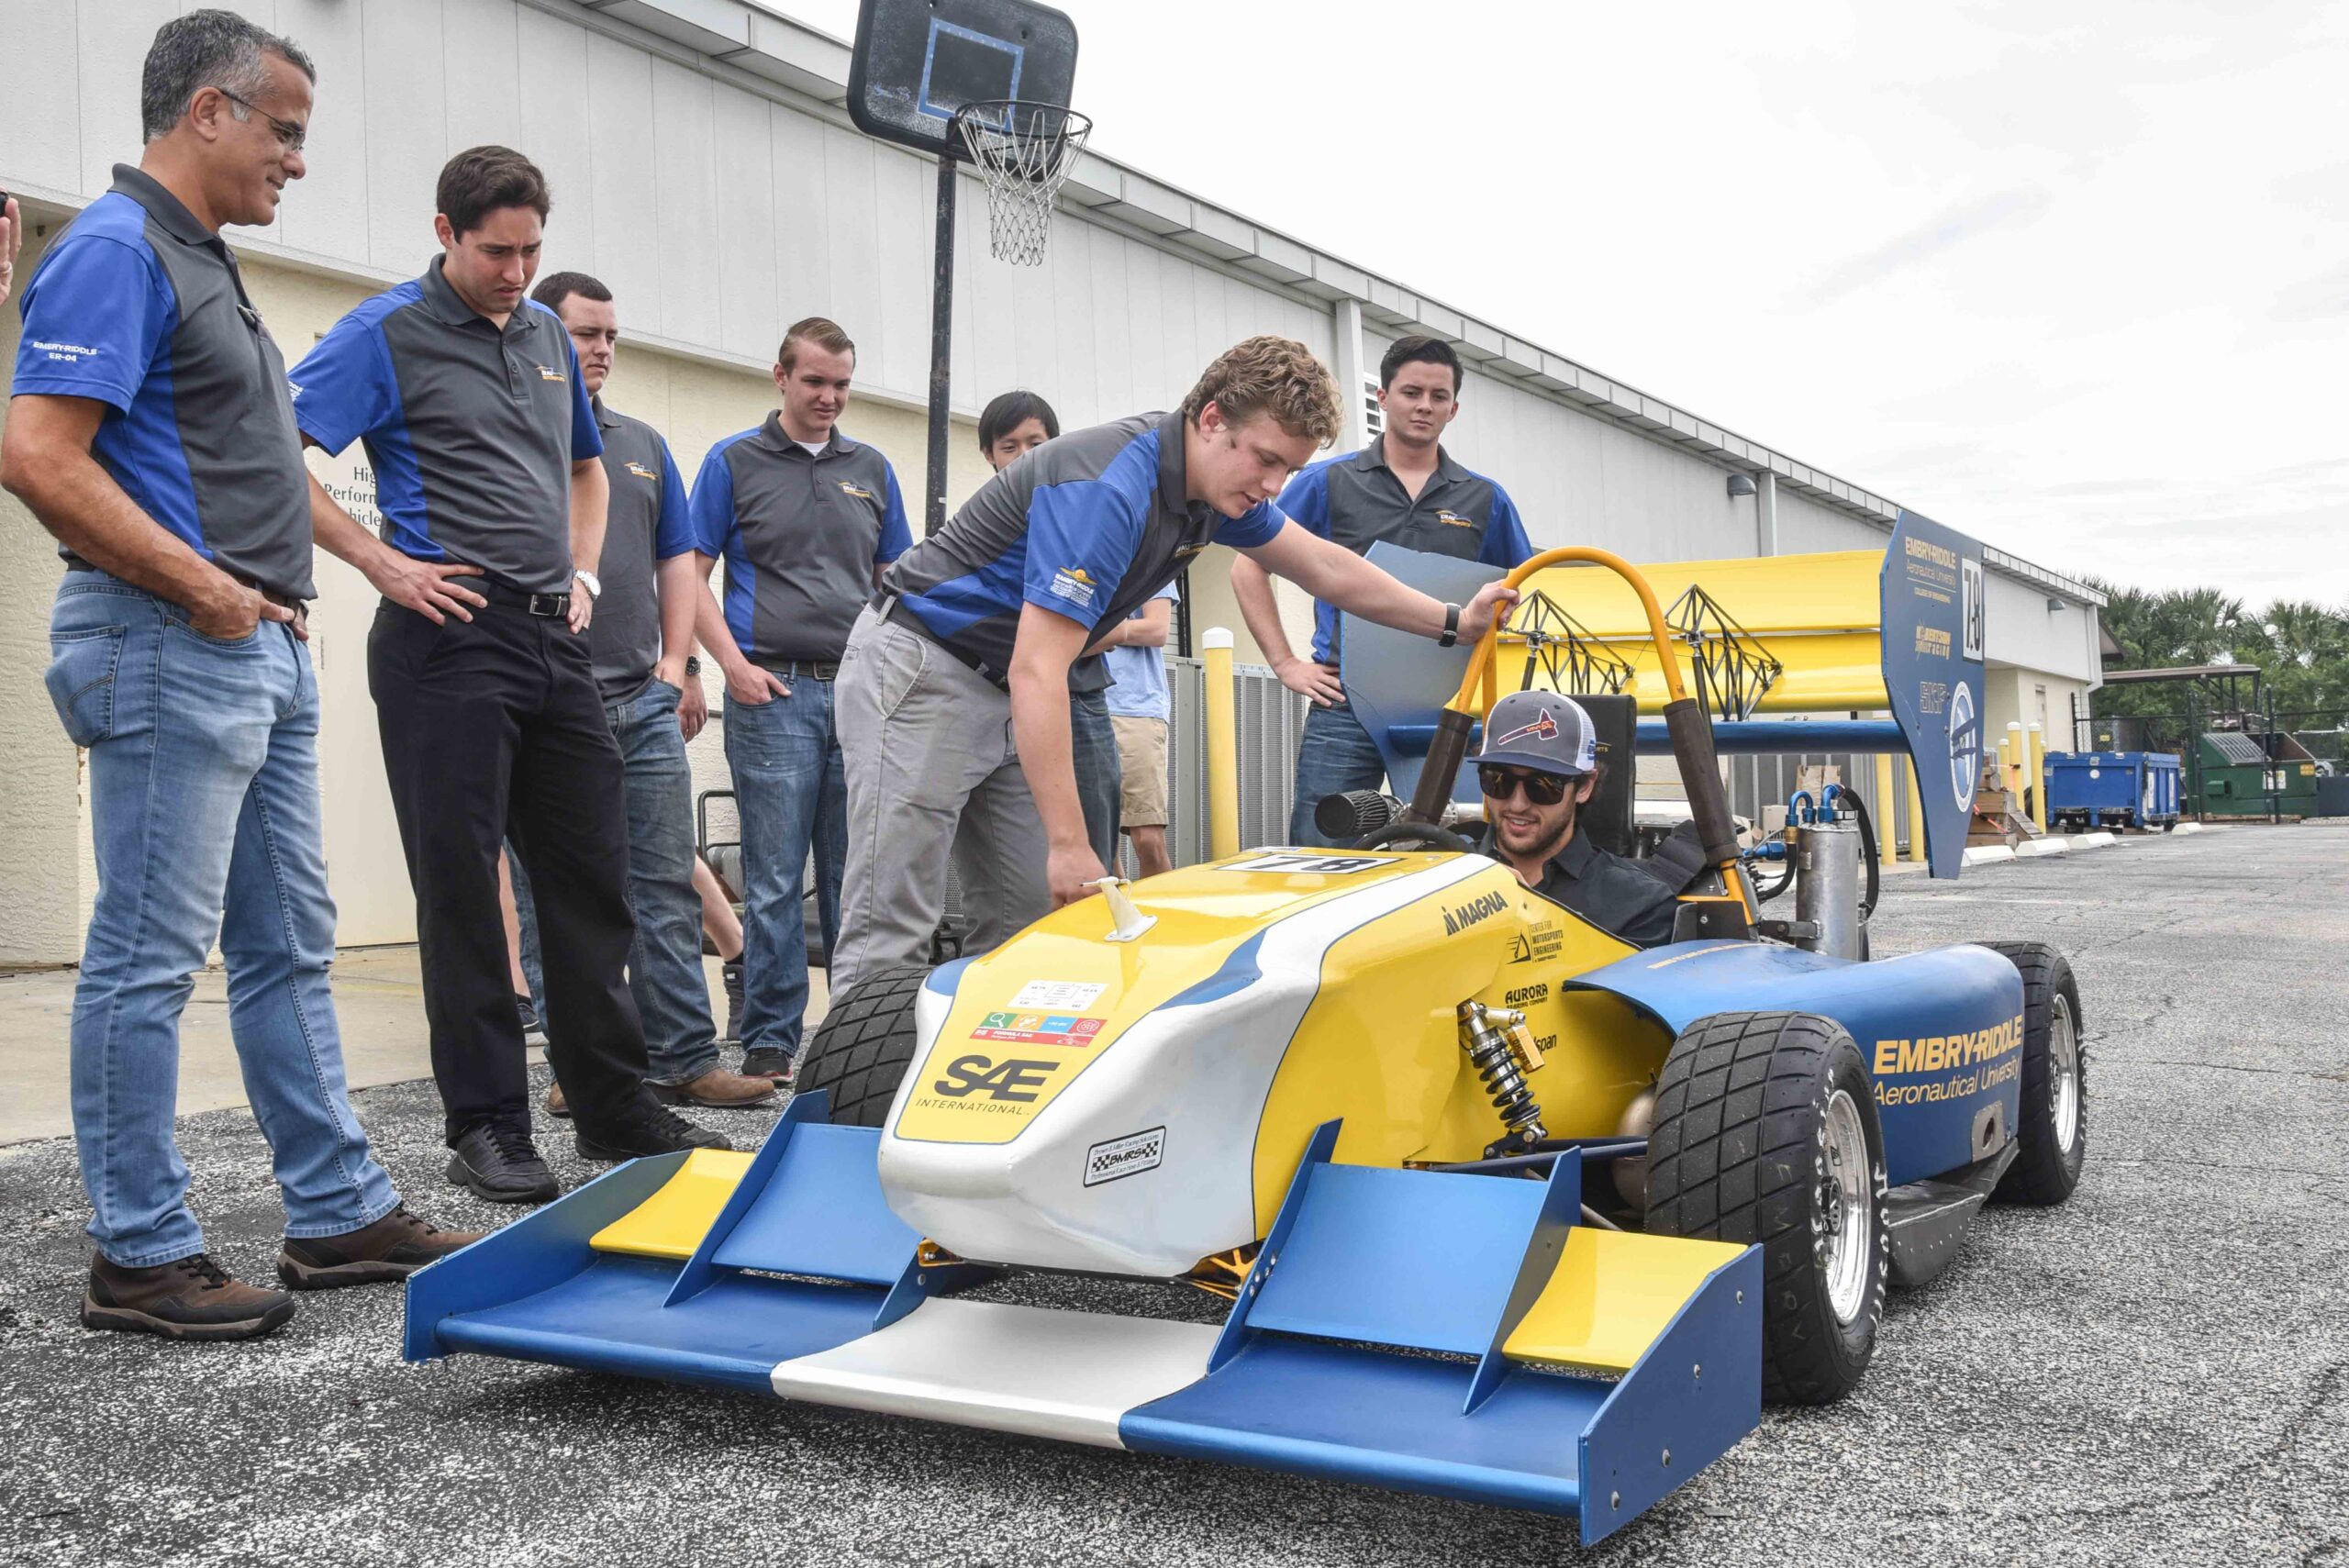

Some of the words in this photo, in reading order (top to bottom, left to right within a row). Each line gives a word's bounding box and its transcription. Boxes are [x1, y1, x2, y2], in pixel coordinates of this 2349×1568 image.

[350, 507, 382, 526] hicle
[1905, 536, 1956, 570] EMBRY-RIDDLE
[1246, 855, 1378, 872] 78
[1455, 891, 1508, 929] MAGNA
[1532, 929, 1563, 944] MOTORSPORTS
[1534, 941, 1562, 956] ENGINEERING
[1505, 984, 1548, 1004] AURORA
[1873, 1015, 2022, 1074] EMBRY-RIDDLE
[934, 1054, 1061, 1103] SAE
[1874, 1069, 1979, 1106] Aeronautical
[1981, 1055, 2020, 1090] University
[916, 1098, 1024, 1116] INTERNATIONAL
[1109, 1148, 1142, 1165] BMRS
